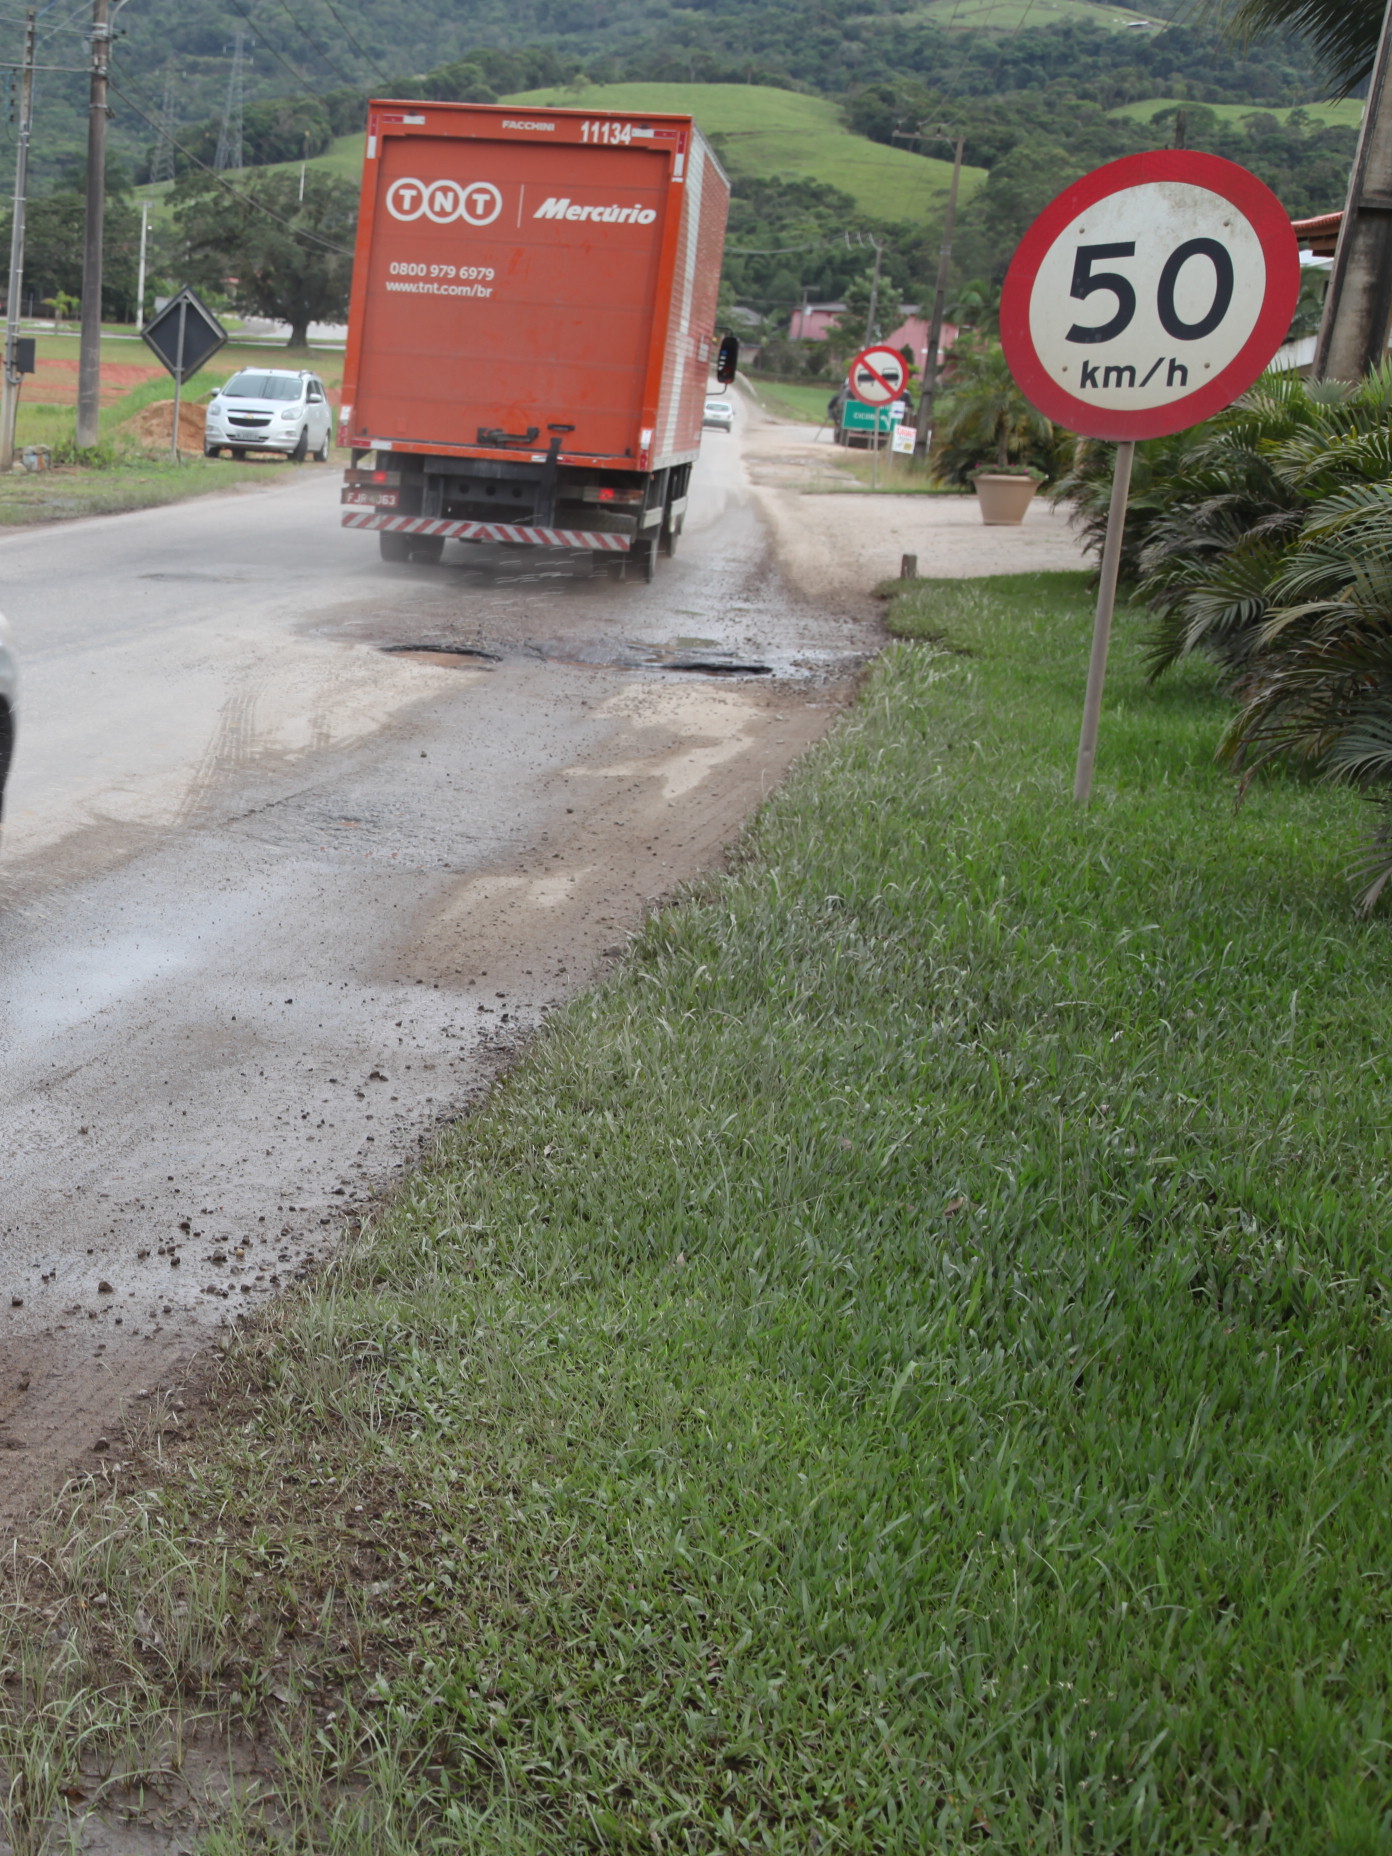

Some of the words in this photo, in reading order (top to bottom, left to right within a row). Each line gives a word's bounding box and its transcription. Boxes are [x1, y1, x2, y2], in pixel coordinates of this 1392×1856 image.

[501, 119, 555, 132] FACCHINI
[580, 120, 633, 145] 11134
[396, 186, 493, 218] TNT
[532, 197, 657, 225] Mercúrio
[389, 262, 426, 278] 0800
[430, 264, 456, 279] 979
[459, 265, 495, 281] 6979
[385, 280, 494, 298] www.tnt.com/br
[1064, 236, 1235, 345] 50
[1079, 356, 1189, 389] km/h
